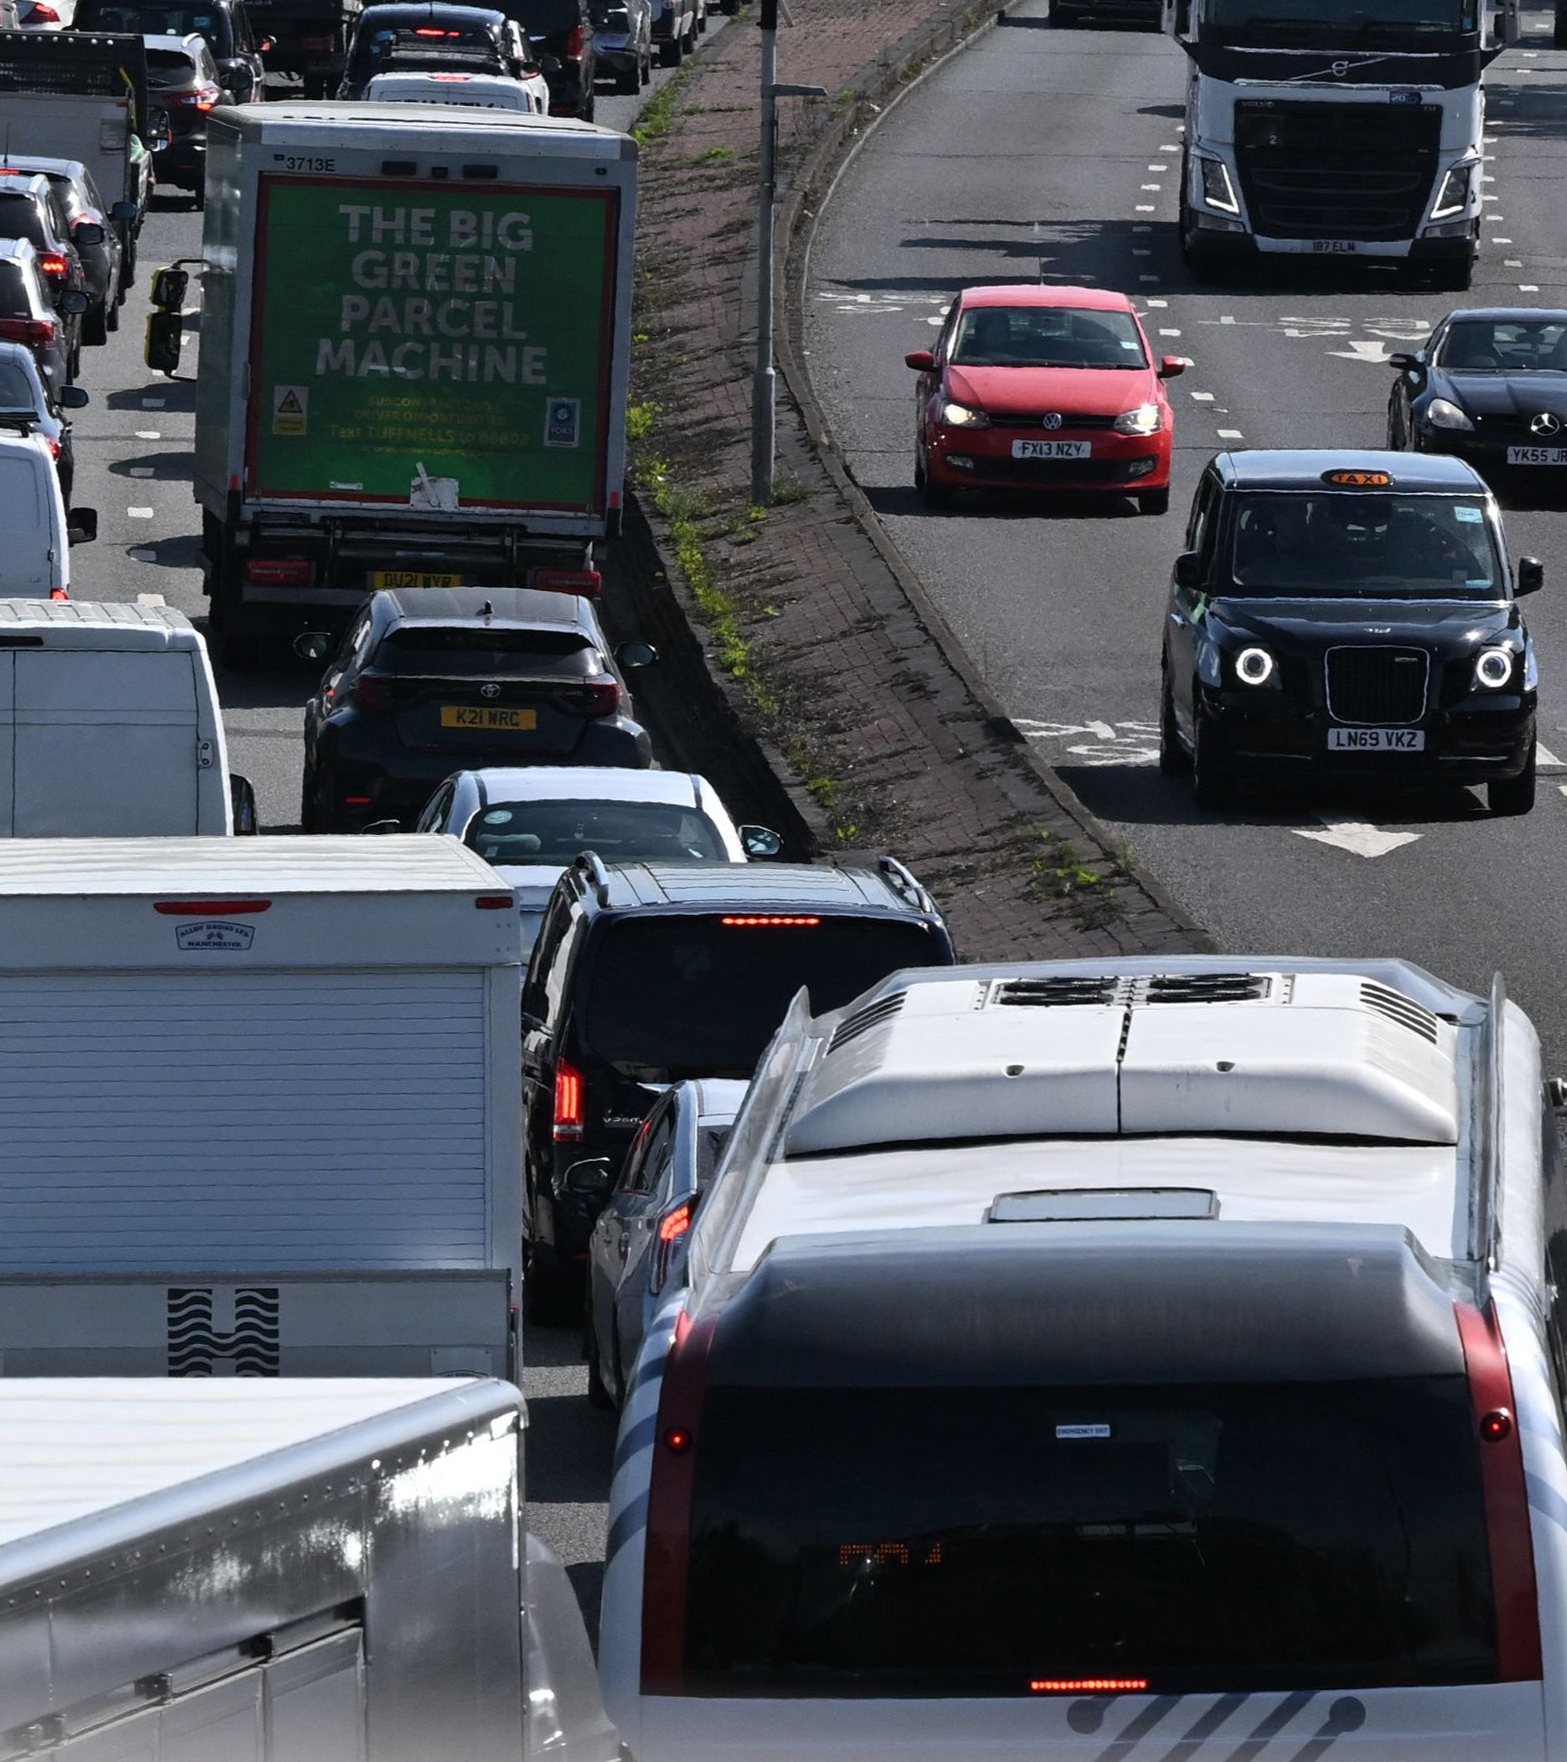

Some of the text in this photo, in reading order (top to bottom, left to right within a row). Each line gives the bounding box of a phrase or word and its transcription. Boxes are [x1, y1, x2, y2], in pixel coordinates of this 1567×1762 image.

[286, 157, 336, 172] 3713E
[339, 205, 533, 251] THE BIG
[351, 250, 516, 294] GREEN
[341, 295, 528, 340] PARCEL
[315, 338, 548, 385] MACHINE
[330, 425, 359, 438] Text
[368, 426, 455, 442] TUFFNELLS
[1021, 442, 1082, 456] FX13 NZY
[1513, 449, 1548, 461] YK55
[1337, 474, 1383, 483] TAXI
[457, 710, 482, 724] K21
[1336, 731, 1417, 747] LN69 VKZ
